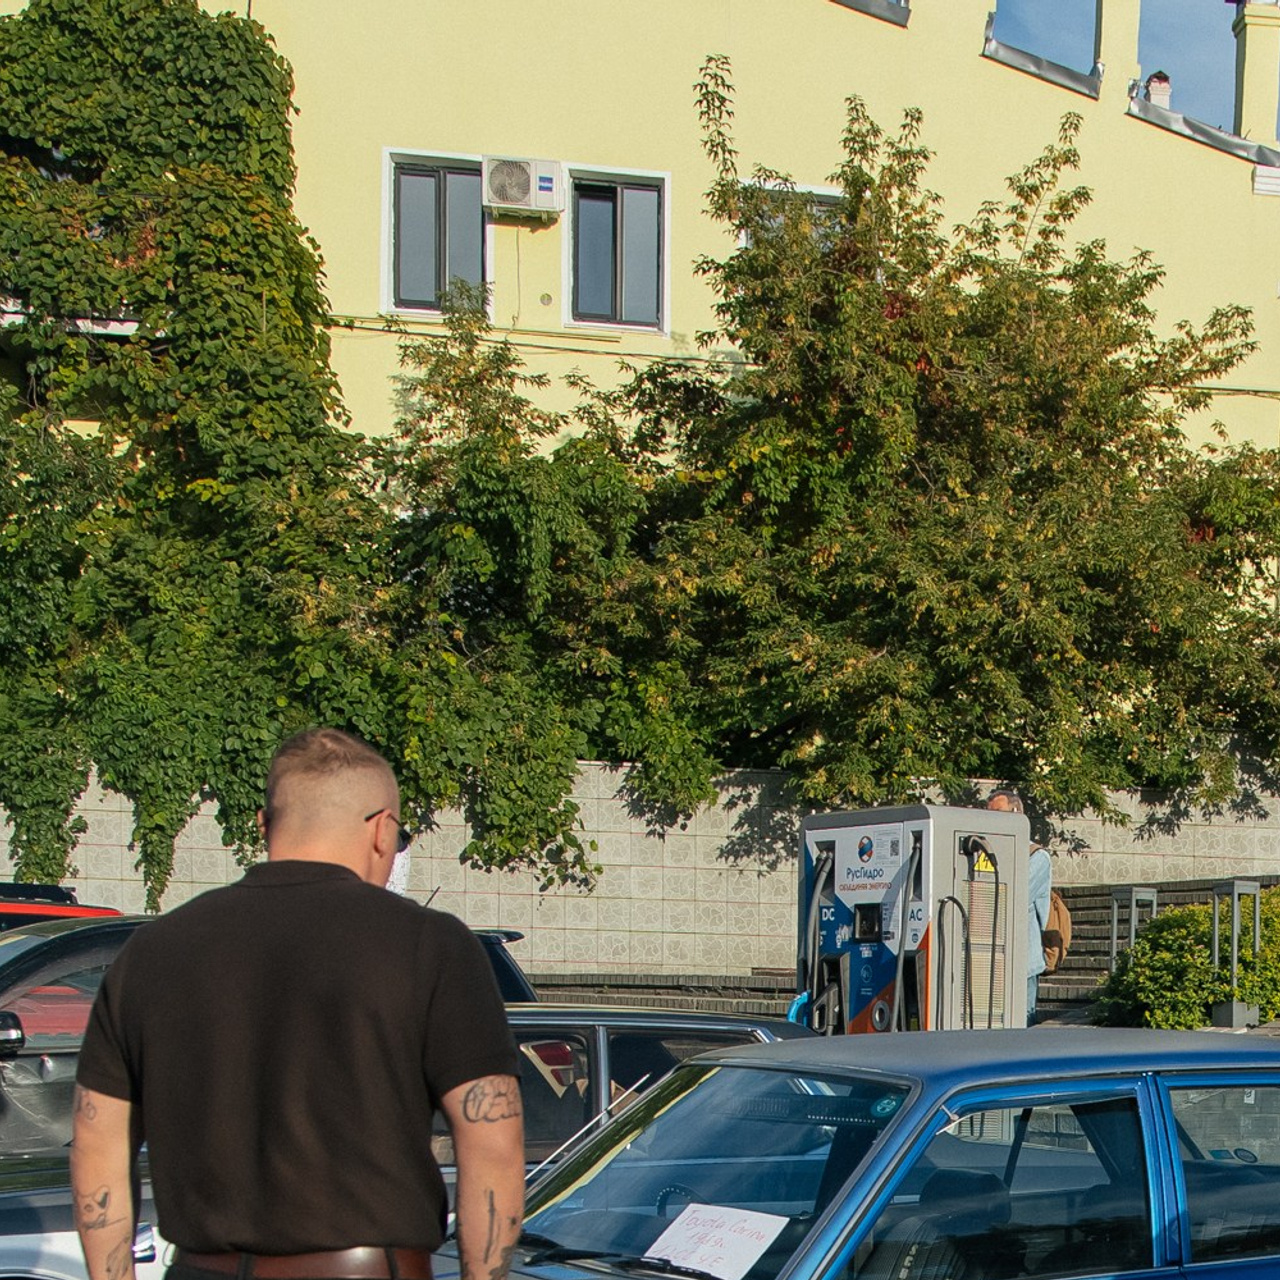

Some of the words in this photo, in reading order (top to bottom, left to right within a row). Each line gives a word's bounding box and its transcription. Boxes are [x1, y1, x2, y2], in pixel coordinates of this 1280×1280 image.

[821, 907, 835, 922] DC
[909, 908, 923, 922] AC
[678, 1209, 726, 1231] Toyota
